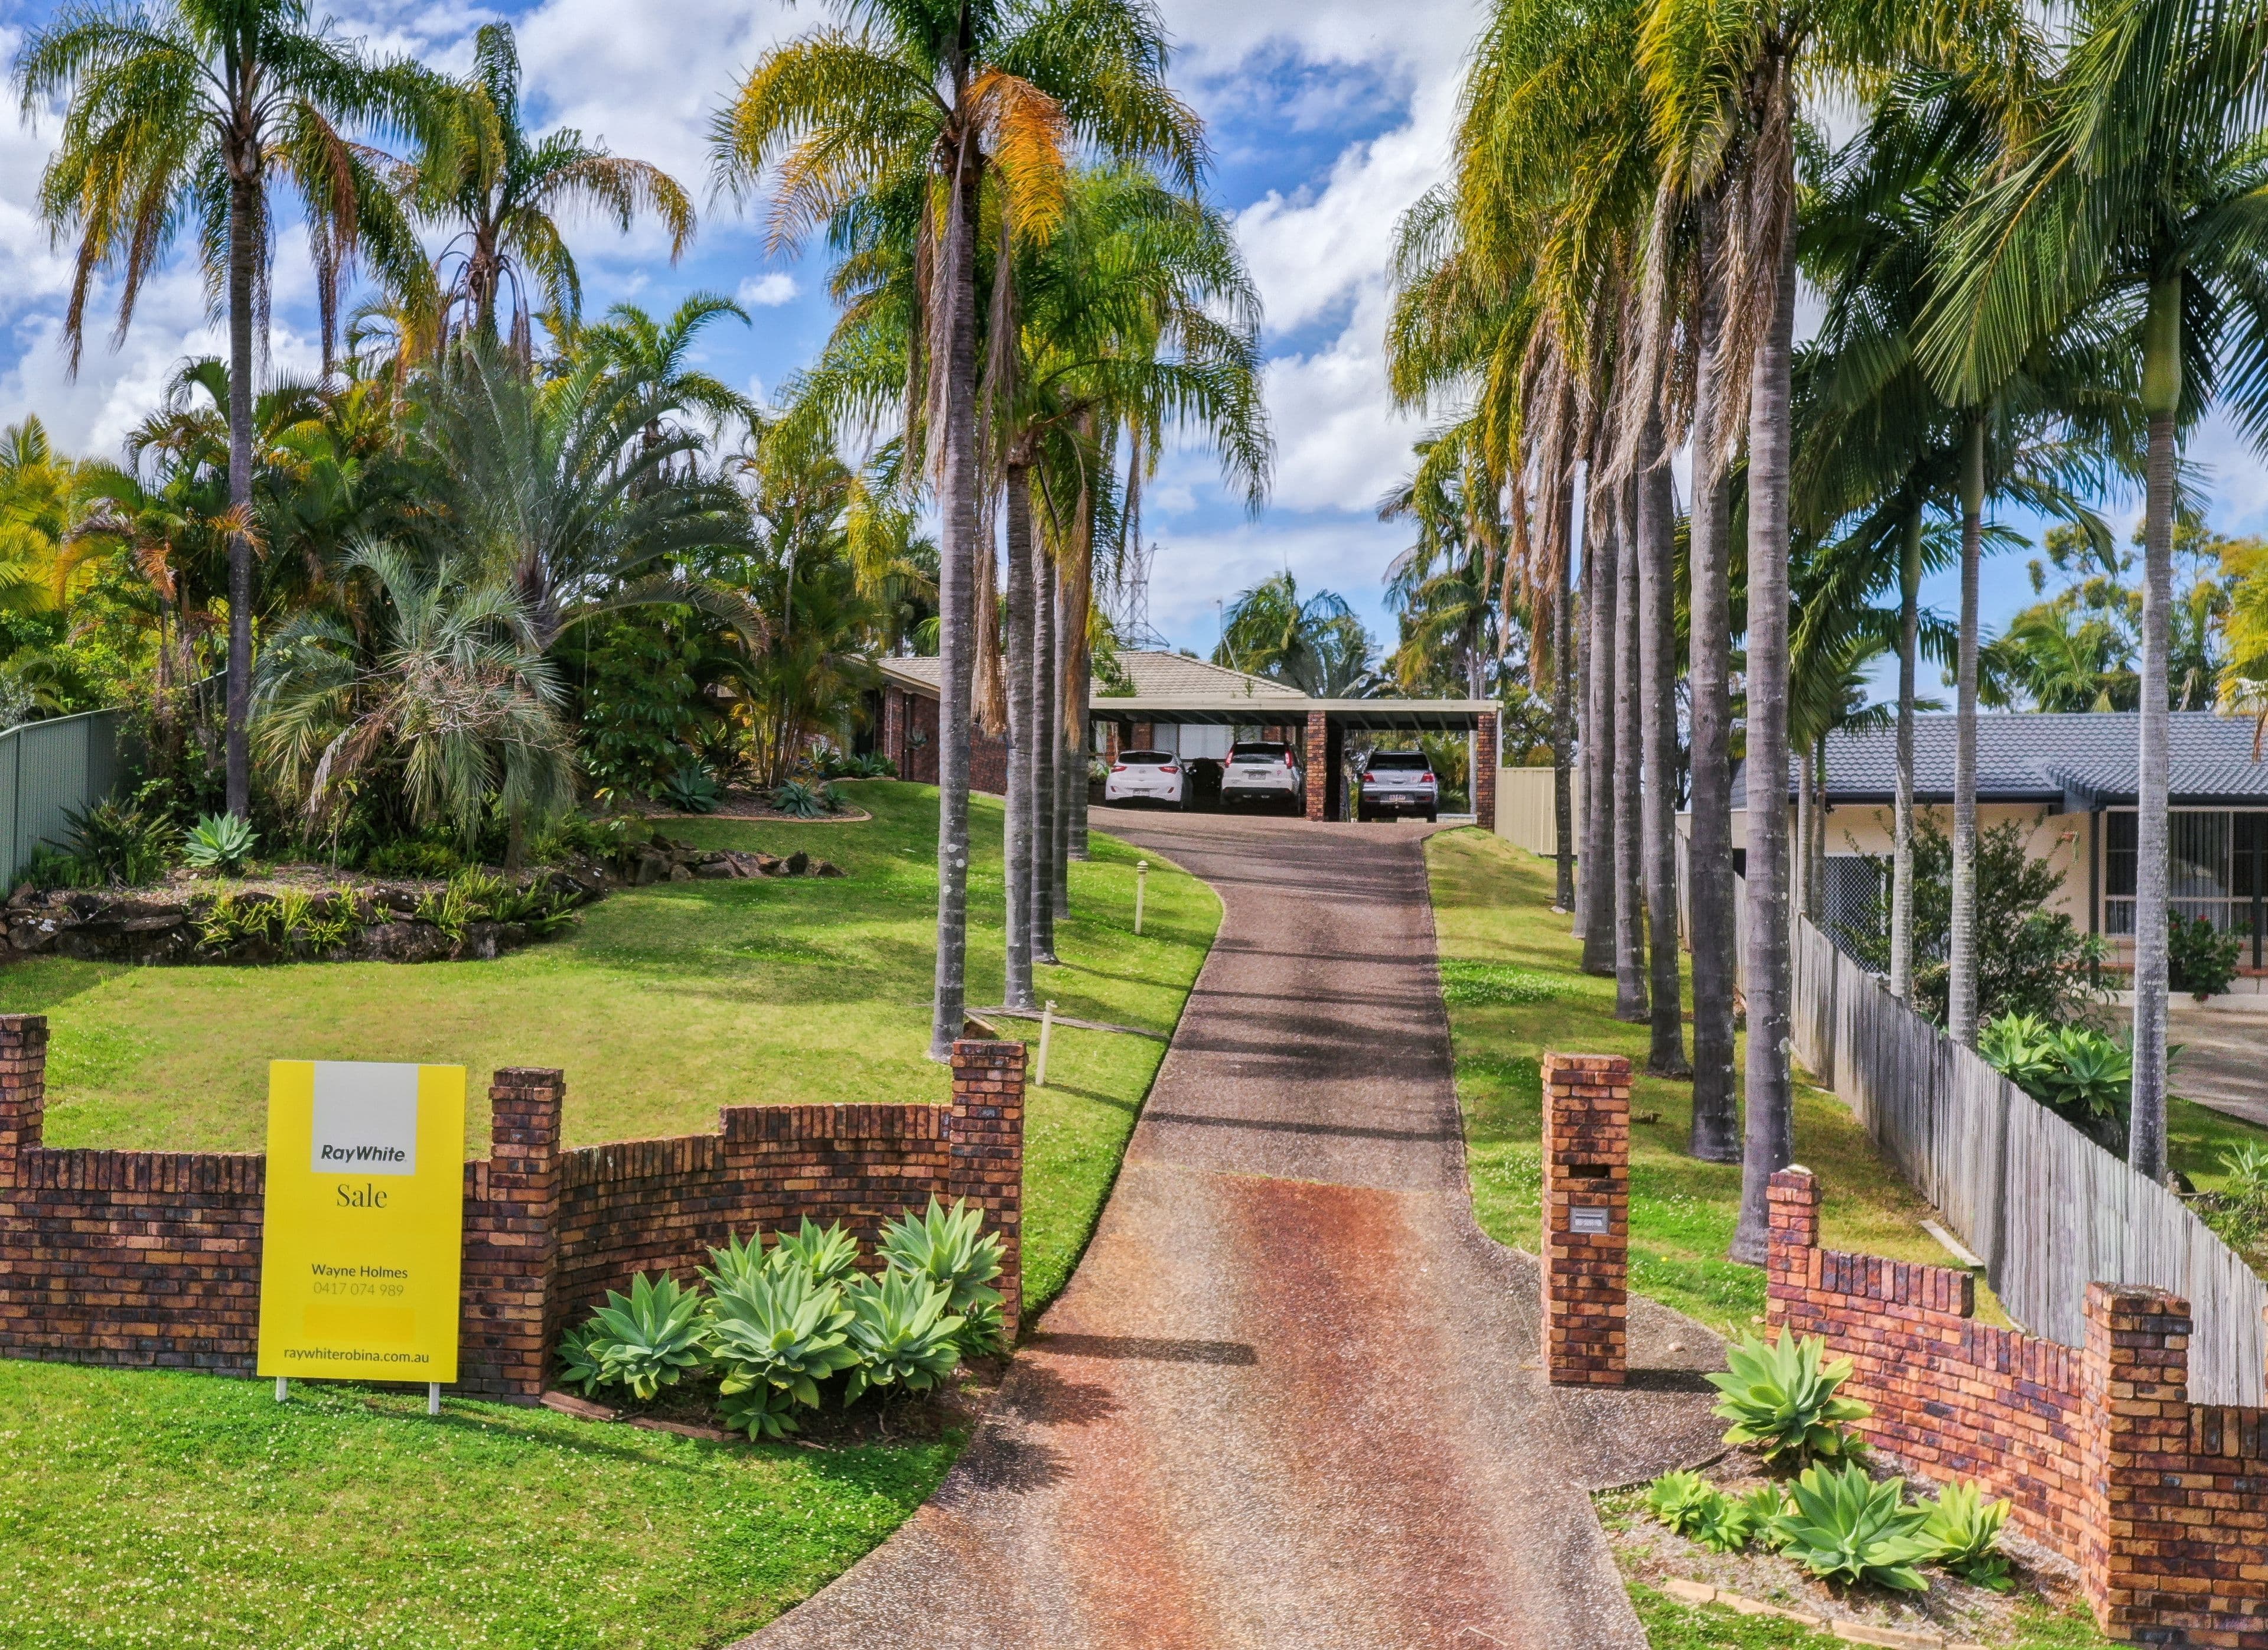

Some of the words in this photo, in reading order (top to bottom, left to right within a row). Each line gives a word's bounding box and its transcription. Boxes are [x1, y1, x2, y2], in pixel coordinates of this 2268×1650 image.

[337, 1182, 387, 1208] Sale
[311, 1263, 356, 1279] Wayne
[360, 1265, 408, 1278] Holmes
[313, 1281, 347, 1295] 0417
[350, 1283, 375, 1296] 074
[379, 1284, 404, 1297] 989
[284, 1347, 429, 1363] raywhiterobina.com.au
